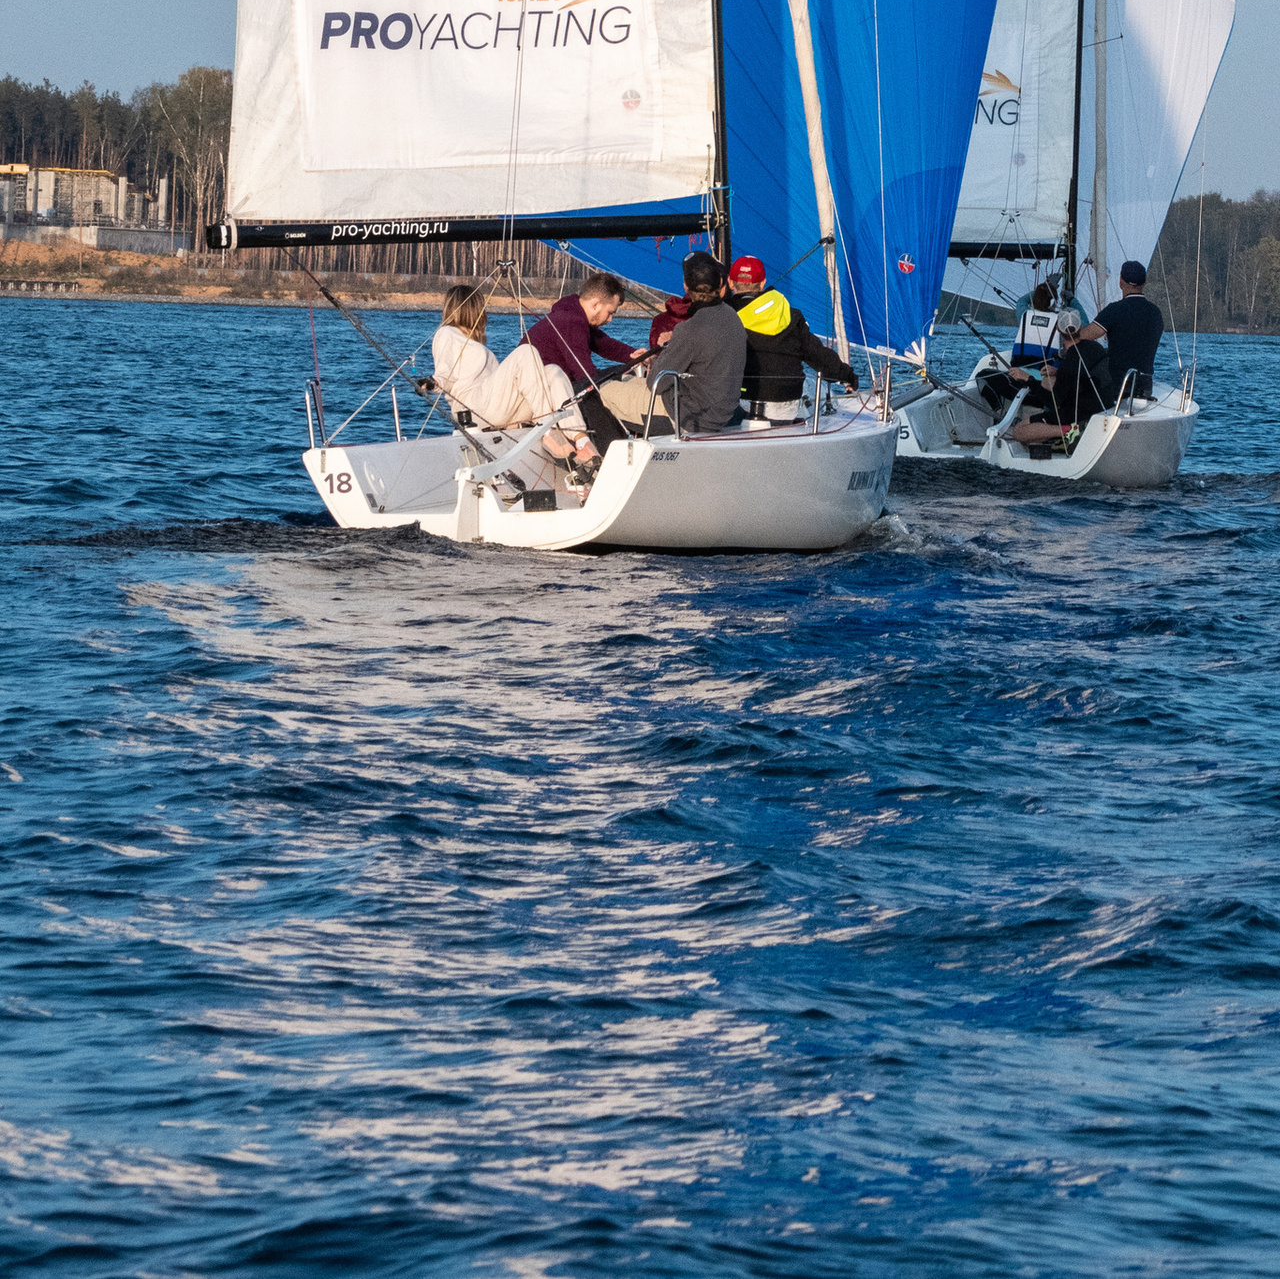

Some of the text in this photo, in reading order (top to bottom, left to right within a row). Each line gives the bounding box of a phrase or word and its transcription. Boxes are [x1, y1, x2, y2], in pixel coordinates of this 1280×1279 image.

[320, 6, 632, 50] PROYACHTING
[331, 221, 449, 240] pro-yachting.ru
[899, 425, 909, 440] 5
[324, 472, 353, 493] 18
